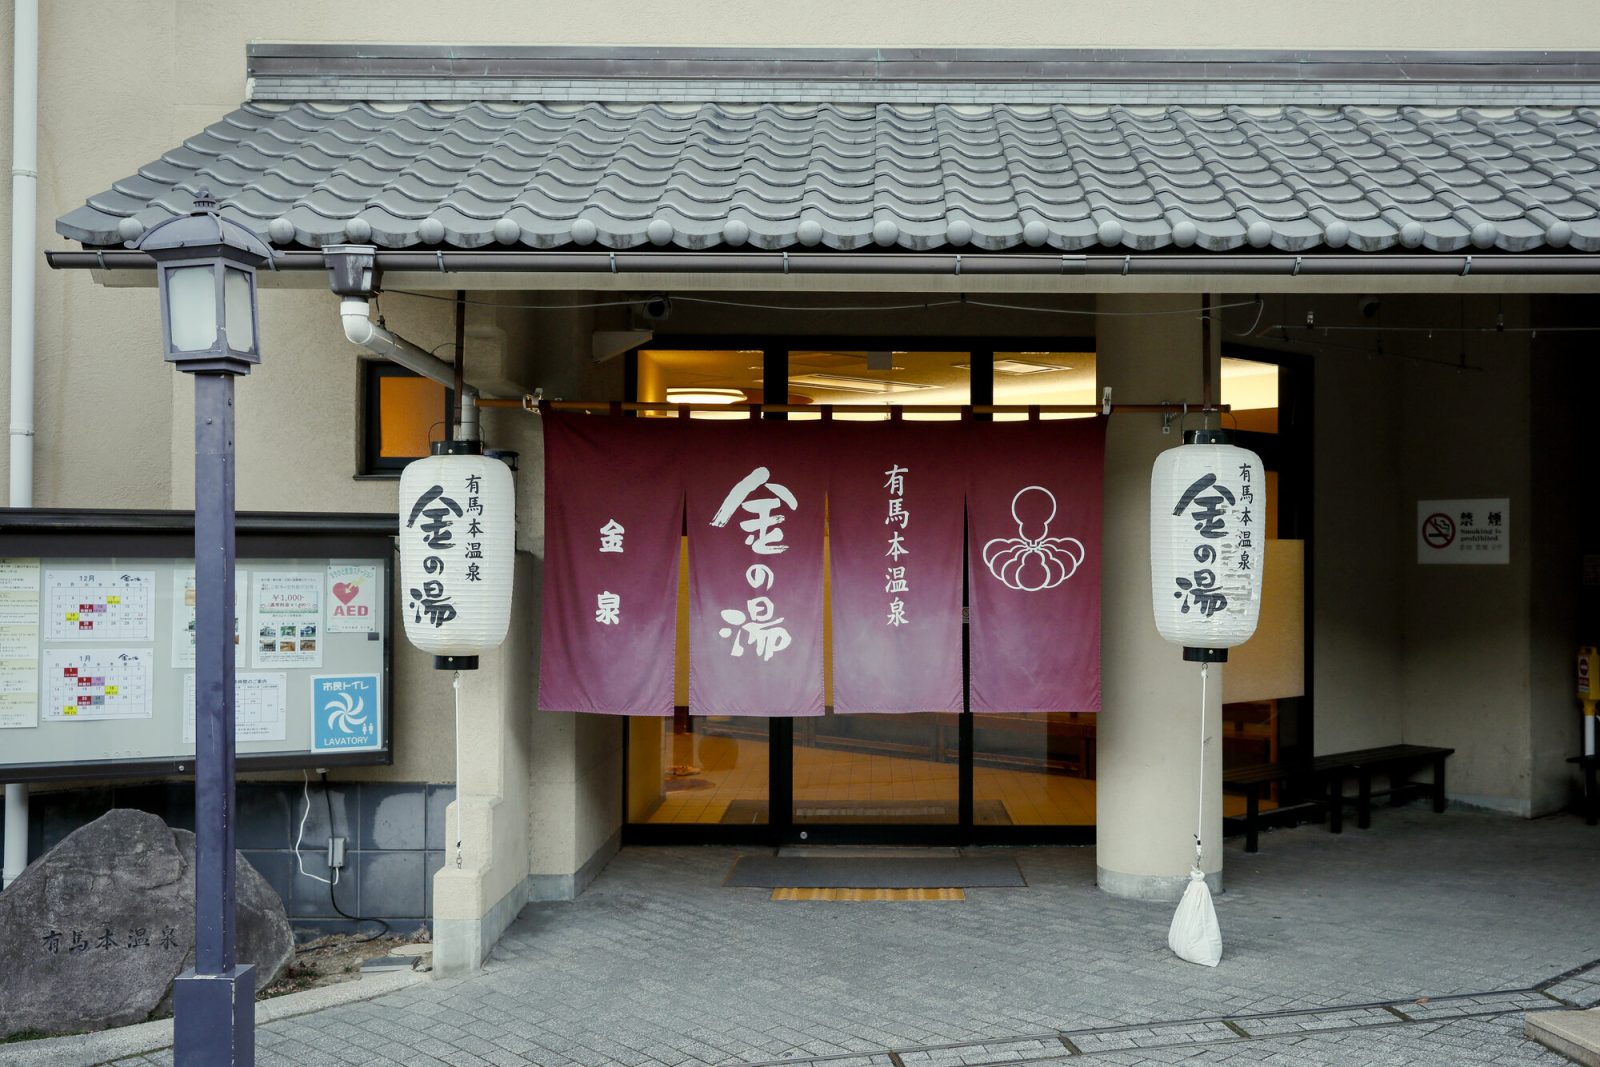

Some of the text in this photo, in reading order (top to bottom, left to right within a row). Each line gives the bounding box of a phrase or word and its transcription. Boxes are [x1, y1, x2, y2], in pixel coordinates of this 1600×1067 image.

[406, 484, 464, 628] 金の湯
[465, 474, 484, 582] 有馬本温泉
[709, 466, 798, 661] 金の湯
[883, 464, 910, 627] 有馬本温泉
[1172, 473, 1236, 618] 金の湯
[1238, 462, 1254, 571] 有馬本温泉
[333, 605, 369, 617] AED
[595, 518, 625, 625] 金泉
[323, 681, 369, 691] 市民トイレ
[324, 737, 369, 746] LAVATORY
[43, 925, 178, 954] 有馬本温泉
